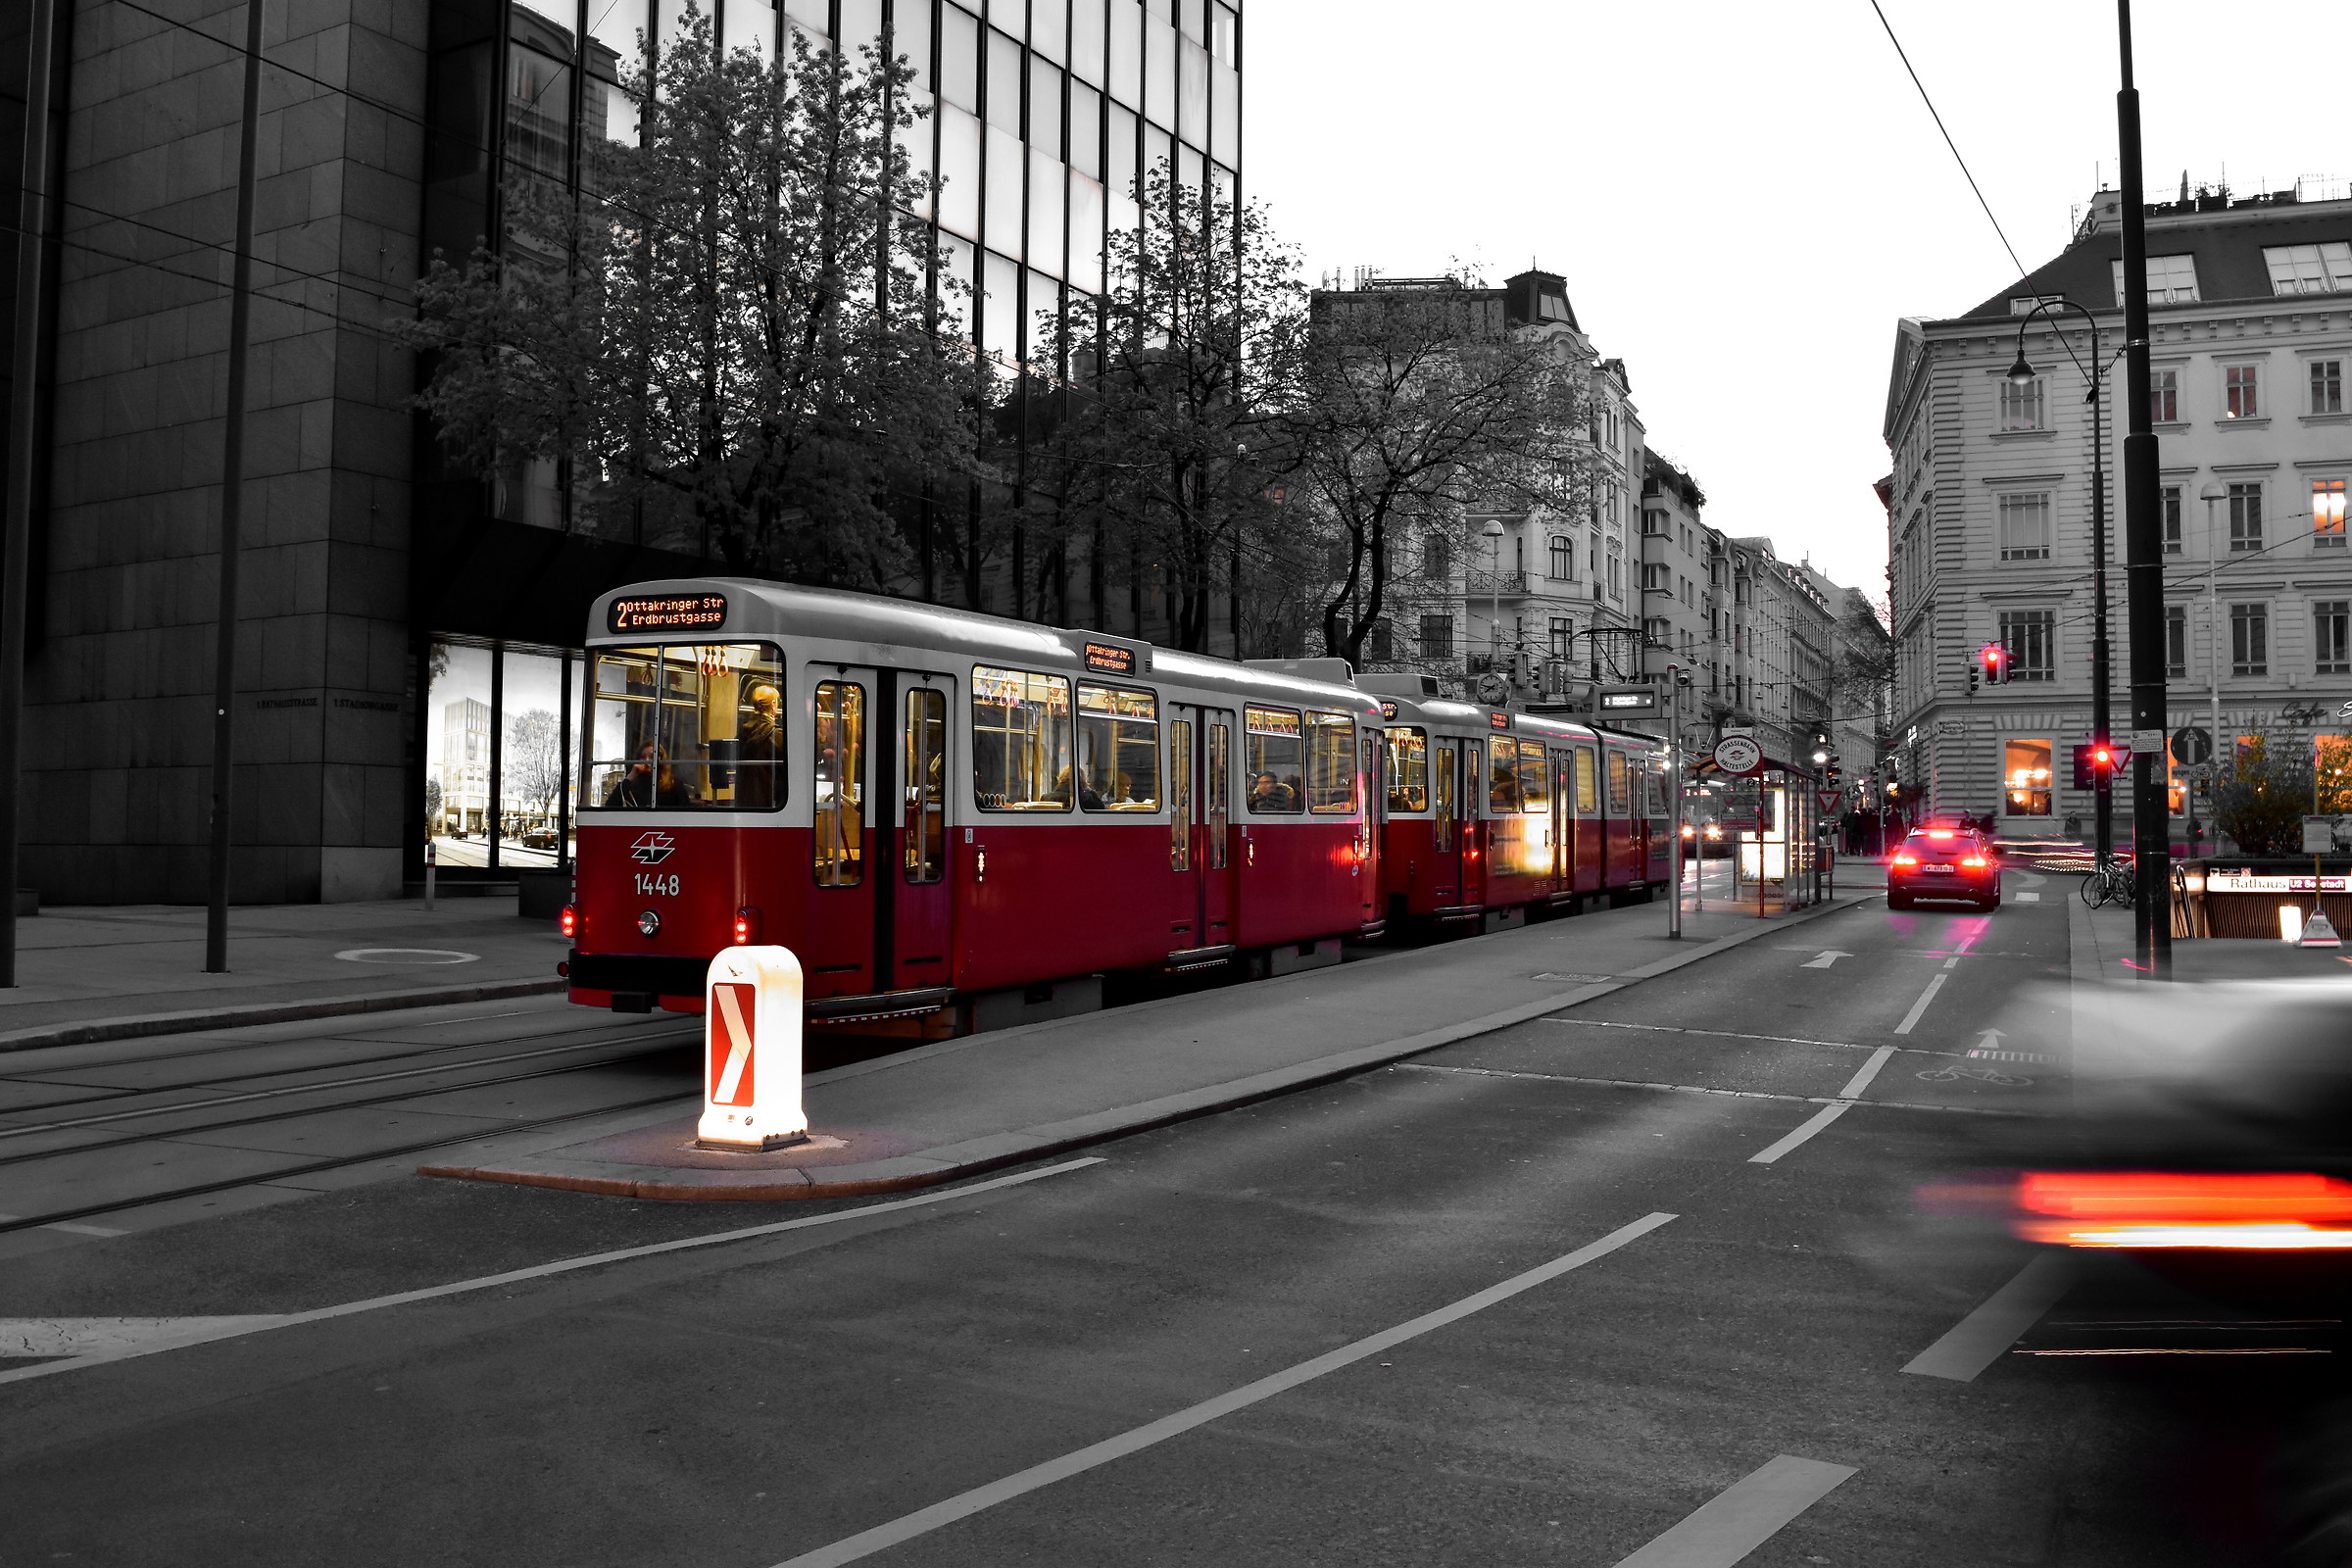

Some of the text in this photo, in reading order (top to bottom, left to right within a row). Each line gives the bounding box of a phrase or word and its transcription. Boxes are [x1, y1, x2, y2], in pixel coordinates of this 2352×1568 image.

[626, 597, 724, 612] Ottakringer Str
[616, 602, 627, 627] 2
[632, 612, 721, 625] Erdbrustgasse
[1090, 656, 1127, 669] Erdbrustgasse
[1719, 740, 1756, 754] STRASSENBAHN
[1720, 759, 1754, 770] HALTESTELLE
[634, 873, 680, 896] 1448
[2230, 878, 2344, 889] Rathaus U2 Sestadt
